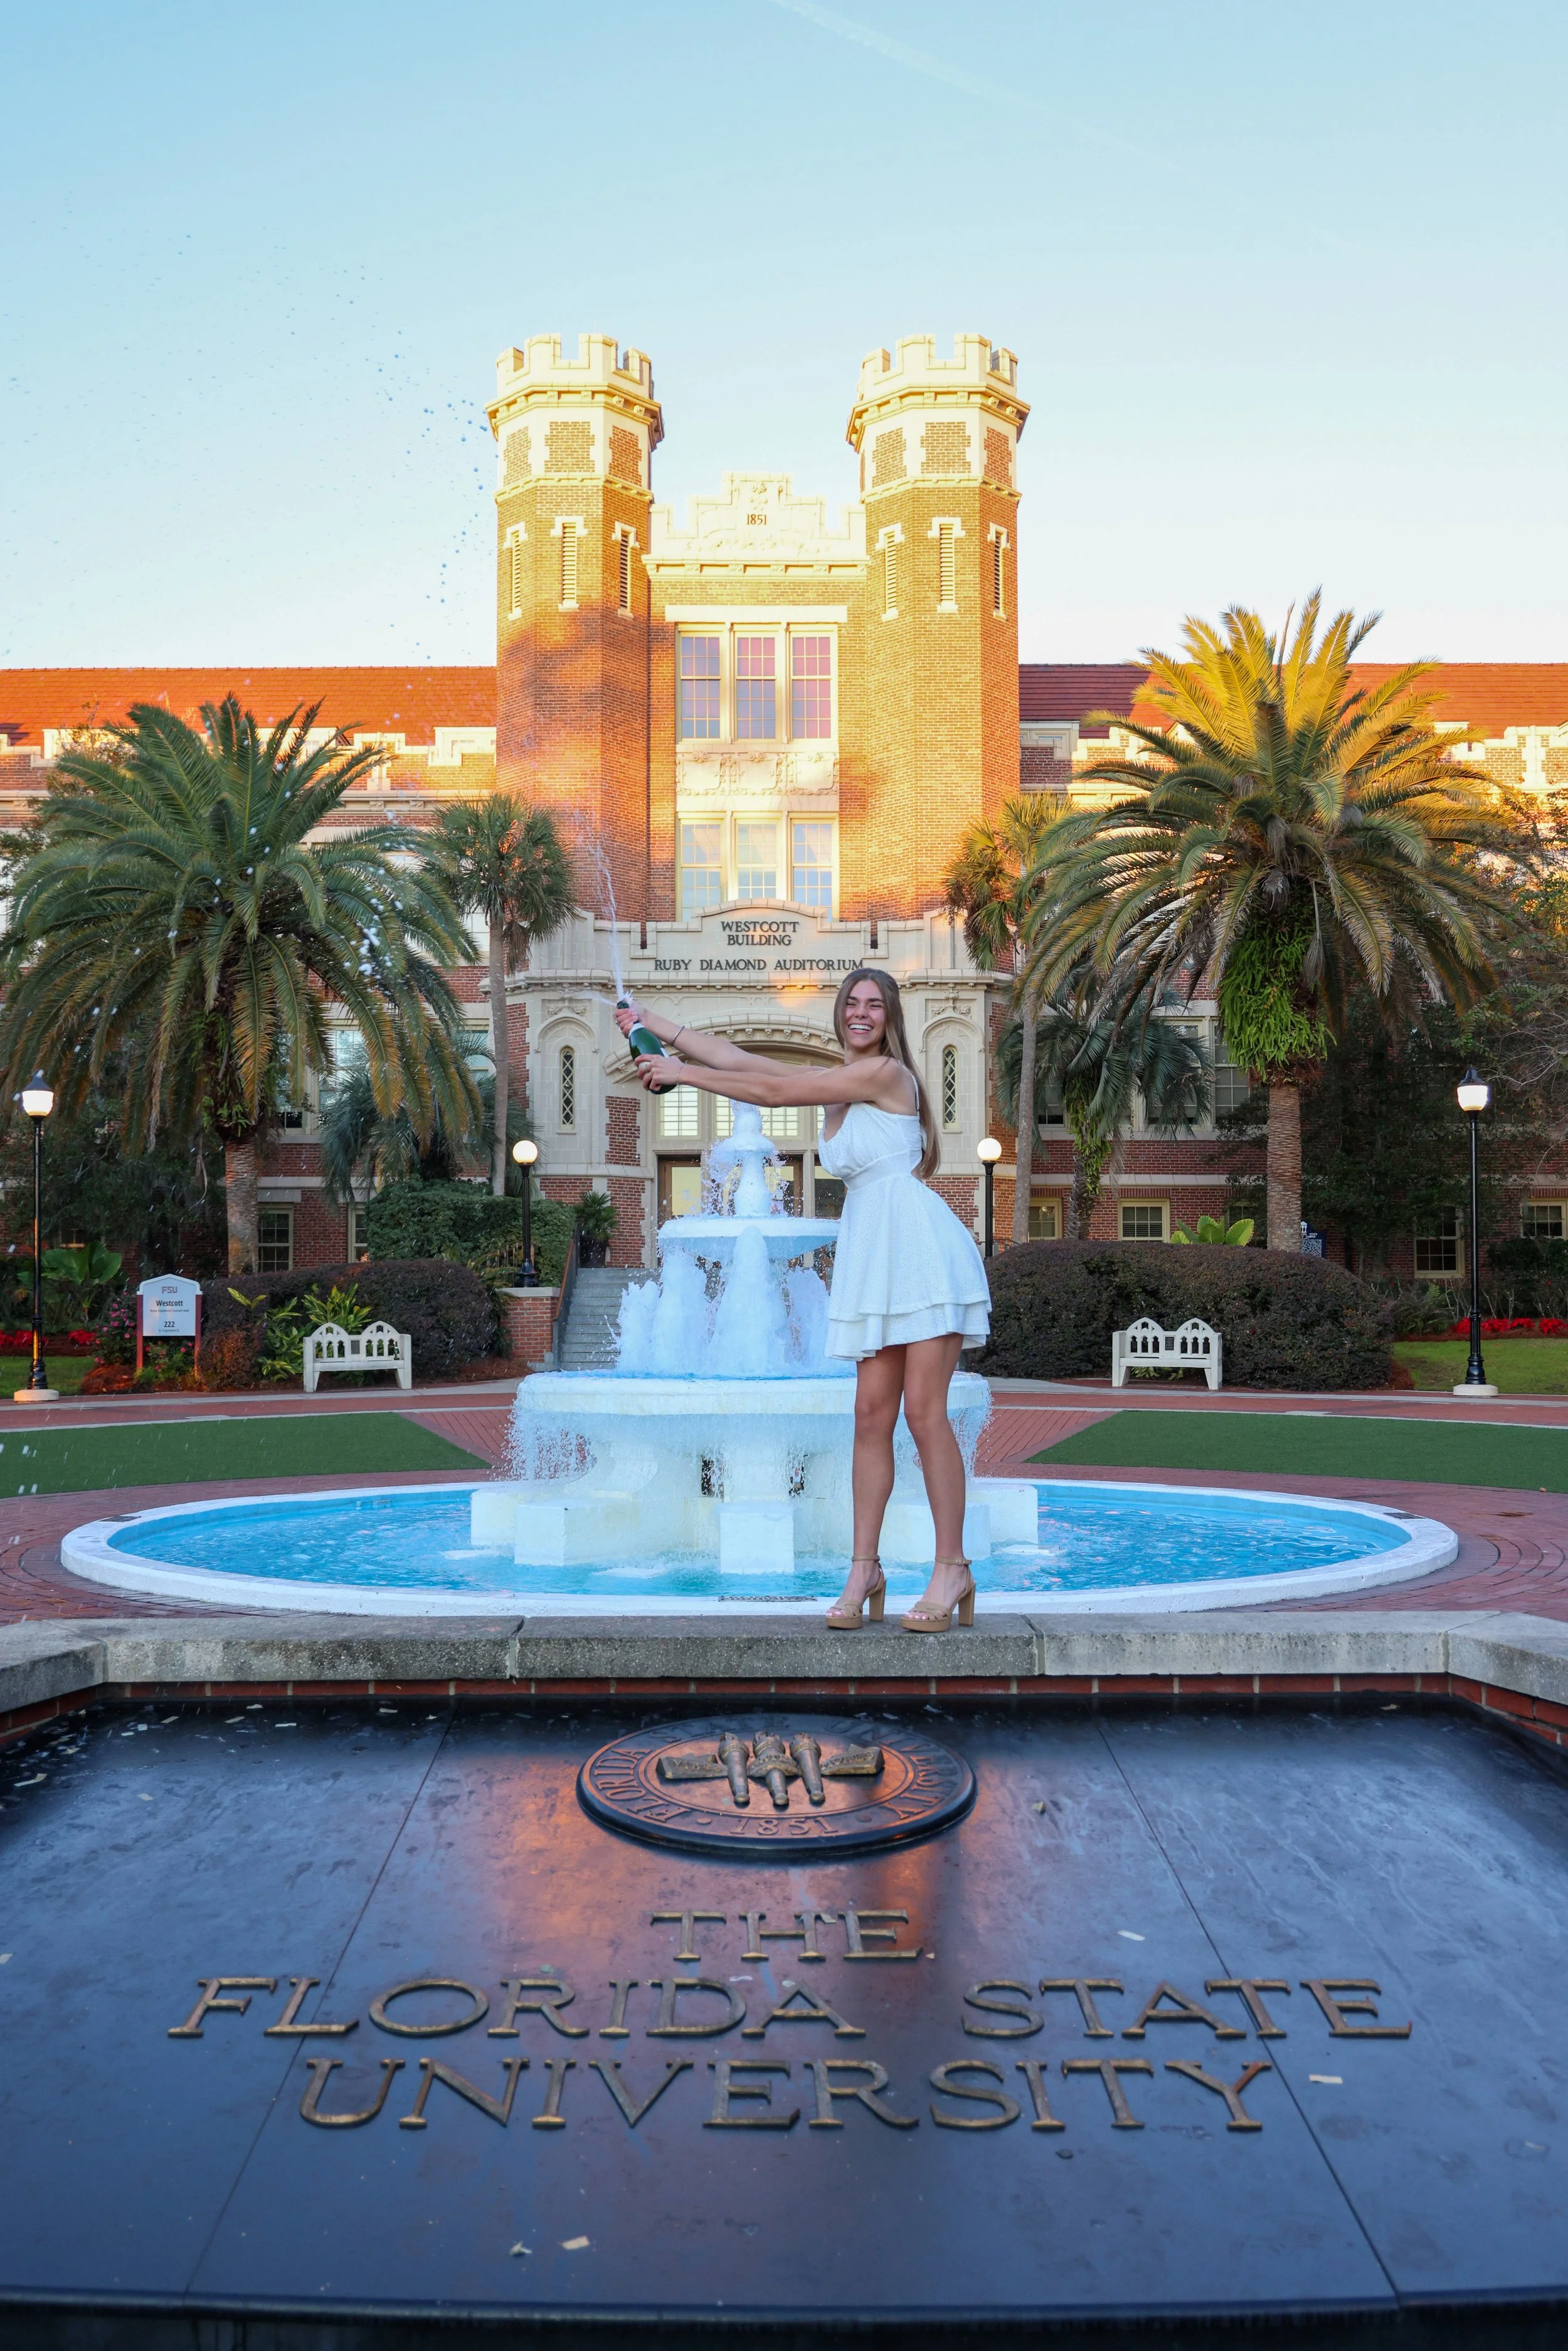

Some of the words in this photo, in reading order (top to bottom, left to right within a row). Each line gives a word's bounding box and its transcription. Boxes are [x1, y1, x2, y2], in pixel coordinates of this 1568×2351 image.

[746, 514, 766, 526] 1851
[721, 921, 799, 933] WESTCOTT
[727, 934, 792, 946] BUILDING
[654, 959, 692, 970] RUBY
[700, 959, 766, 970] DIAMOND
[774, 959, 863, 970] AUDITORIUM
[594, 1748, 691, 1823] FLORIDA
[824, 1721, 958, 1820] UNIVERSITY
[729, 1817, 839, 1835] 1851
[650, 1909, 923, 1961] THE
[167, 1977, 866, 2038] FLORIDA
[961, 1978, 1412, 2039] STATE
[299, 2057, 1272, 2131] UNIVERSITY
